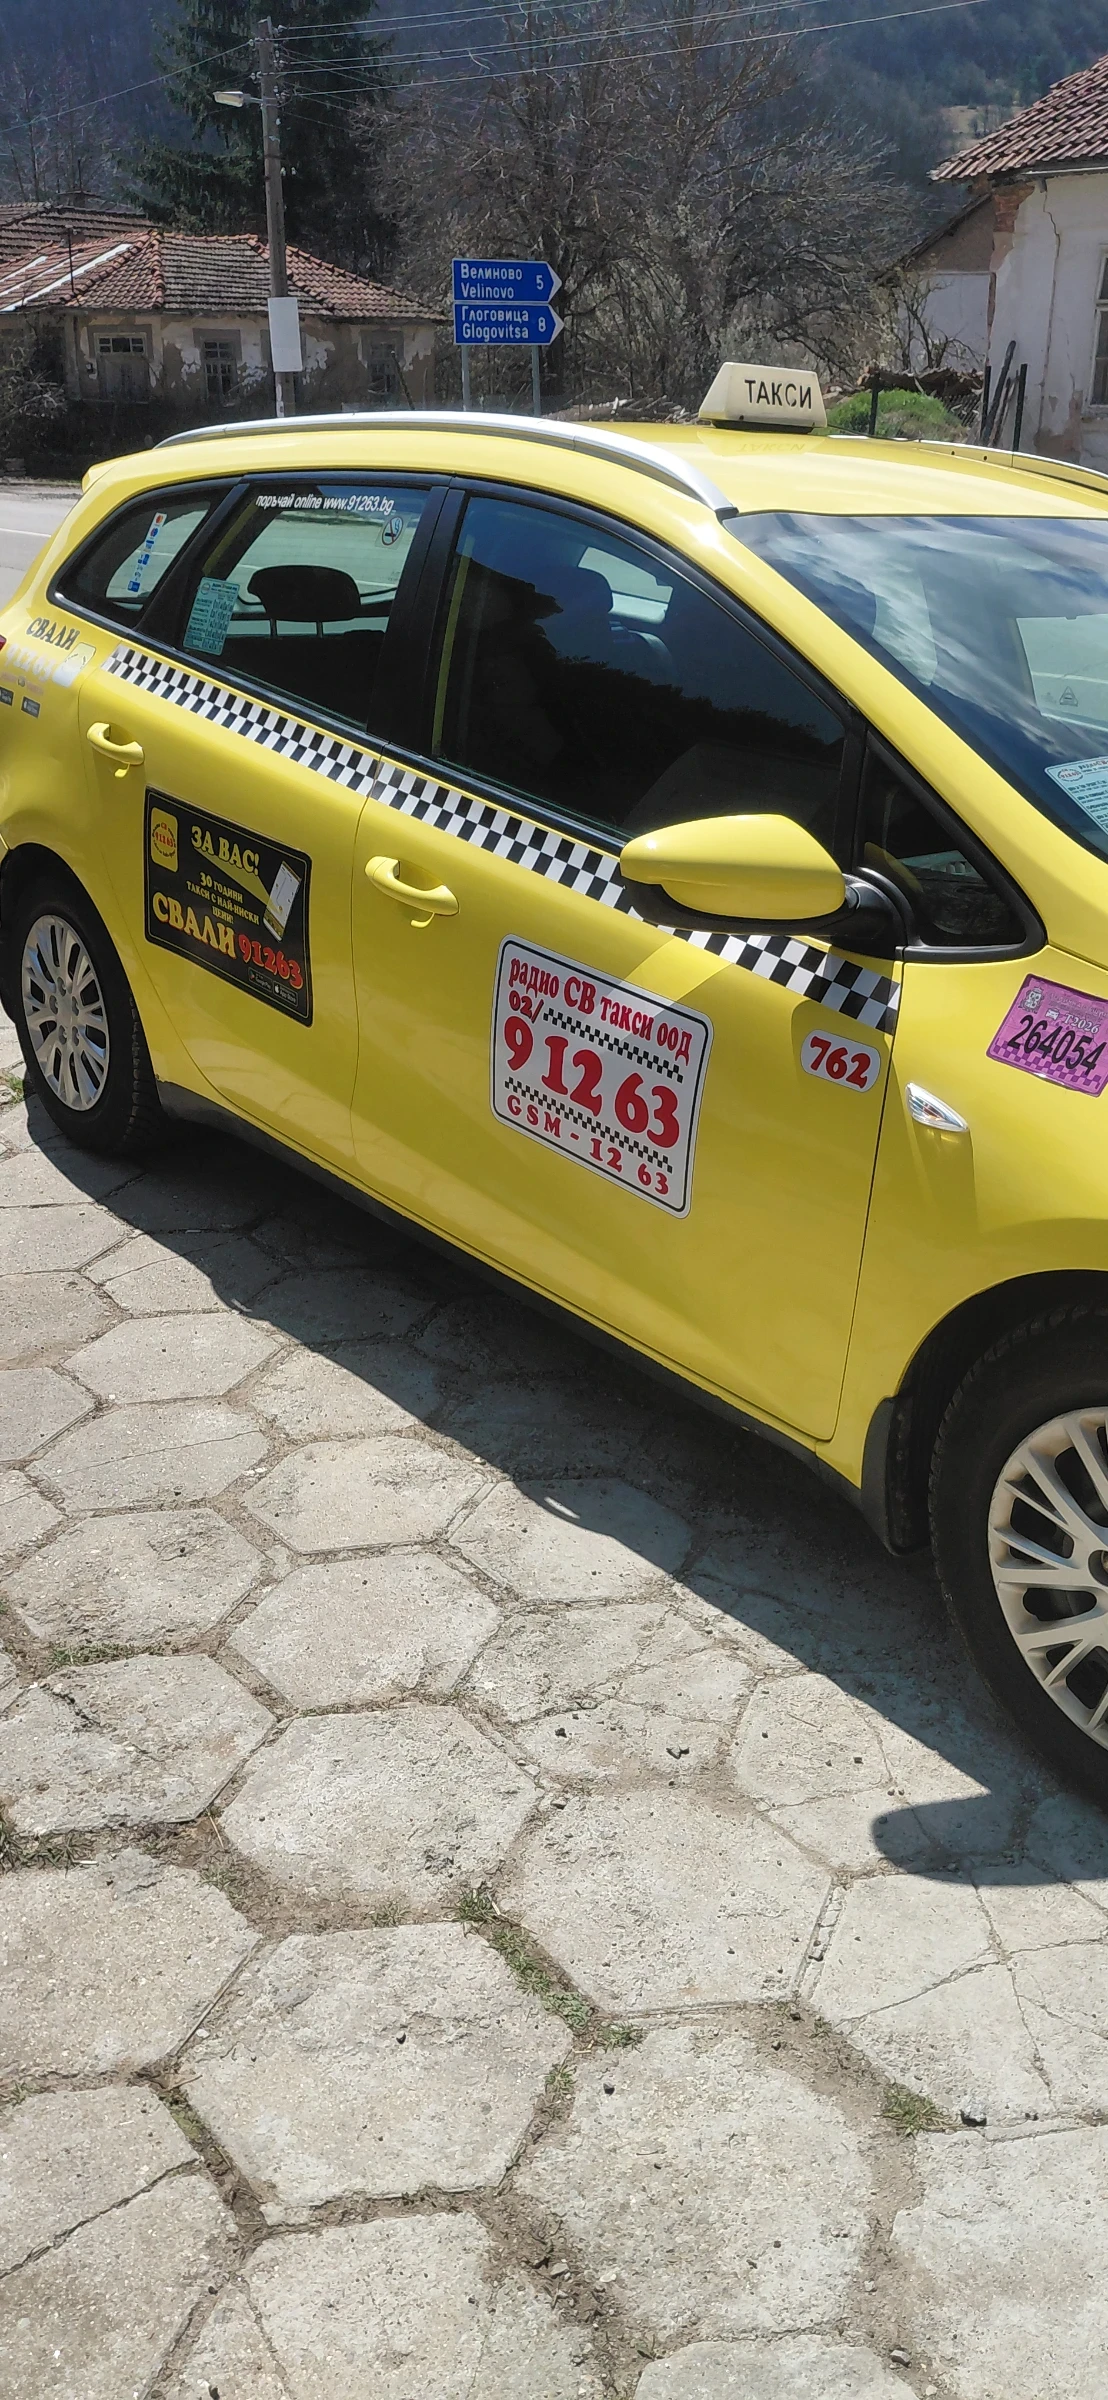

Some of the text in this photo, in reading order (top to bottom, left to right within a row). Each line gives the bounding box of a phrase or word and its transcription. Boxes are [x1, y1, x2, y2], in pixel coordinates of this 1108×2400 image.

[461, 263, 544, 290] Велиново 5
[461, 282, 514, 299] Velinovo
[461, 306, 546, 332] Глоговица 8
[462, 323, 529, 342] Glogovitsa
[744, 379, 812, 409] ТАКСИ
[255, 493, 394, 515] поръчай online www.91263.bg
[25, 617, 80, 650] СВАЛИ
[191, 825, 215, 857] ЗА
[217, 836, 260, 876] ВАС!
[186, 880, 260, 926] ТАКСИ С НАЙ-НИСКИ
[199, 871, 243, 904] 30 ГОДИНИ
[211, 906, 234, 924] ЦЕНИ!
[152, 892, 304, 990] СВАЛИ 91263
[508, 989, 545, 1024] 02/
[508, 957, 693, 1067] радио СВ такси оод
[1064, 1013, 1100, 1034] T2026
[1007, 1014, 1107, 1076] 264054
[809, 1036, 872, 1089] 762
[503, 1015, 680, 1149] 9 12 63
[507, 1094, 562, 1138] GSM
[589, 1137, 623, 1173] 12
[637, 1162, 670, 1196] 63
